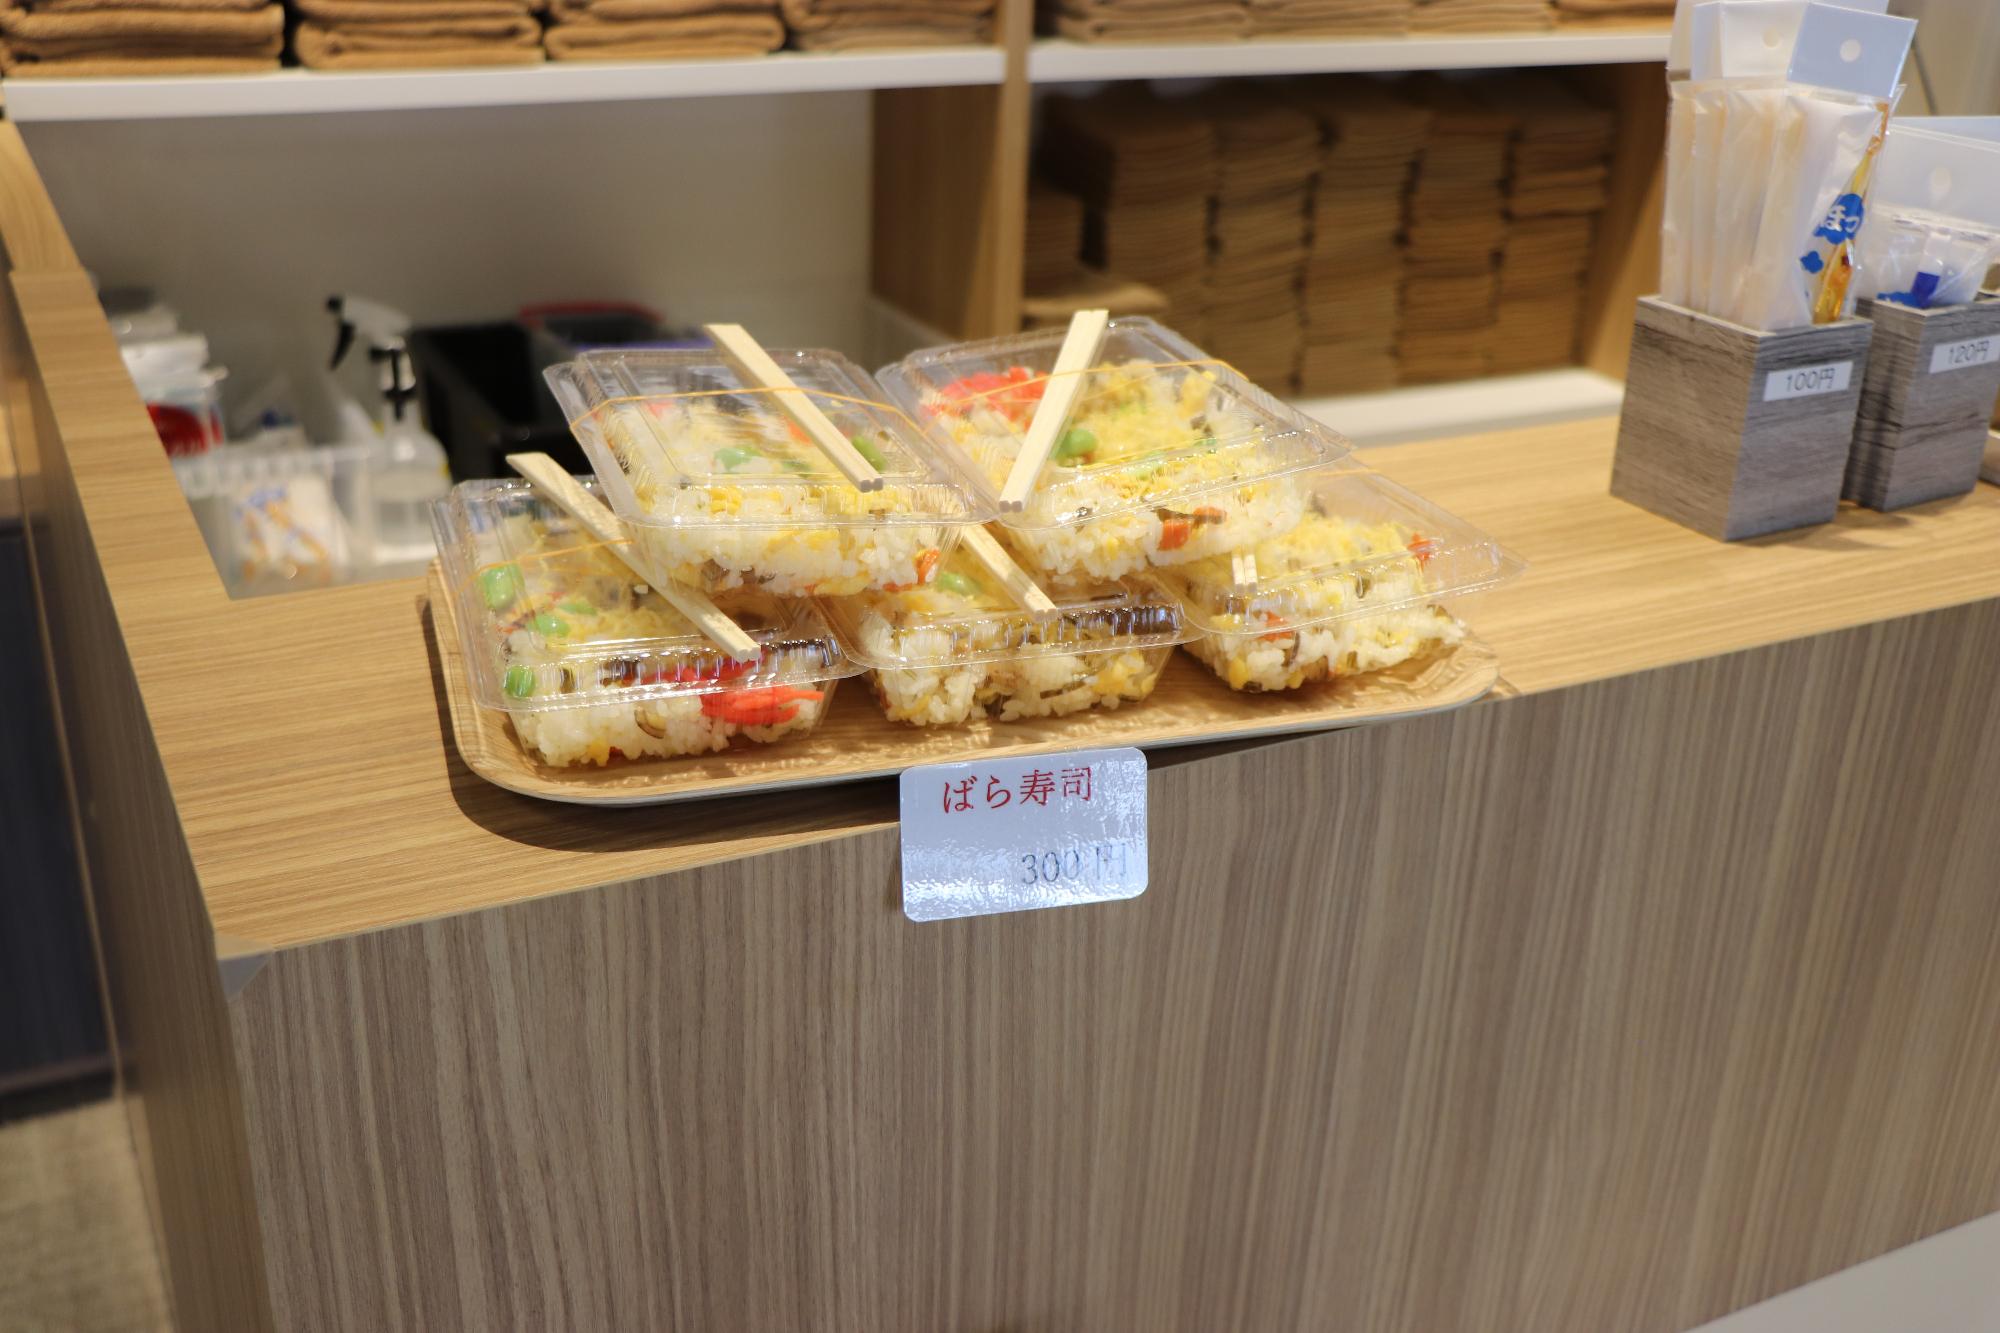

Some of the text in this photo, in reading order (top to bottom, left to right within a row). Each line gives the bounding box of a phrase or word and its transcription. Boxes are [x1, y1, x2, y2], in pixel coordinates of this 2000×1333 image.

[1948, 340, 1991, 366] 120円
[1785, 366, 1837, 393] 100円
[943, 766, 1092, 814] ばら寿司
